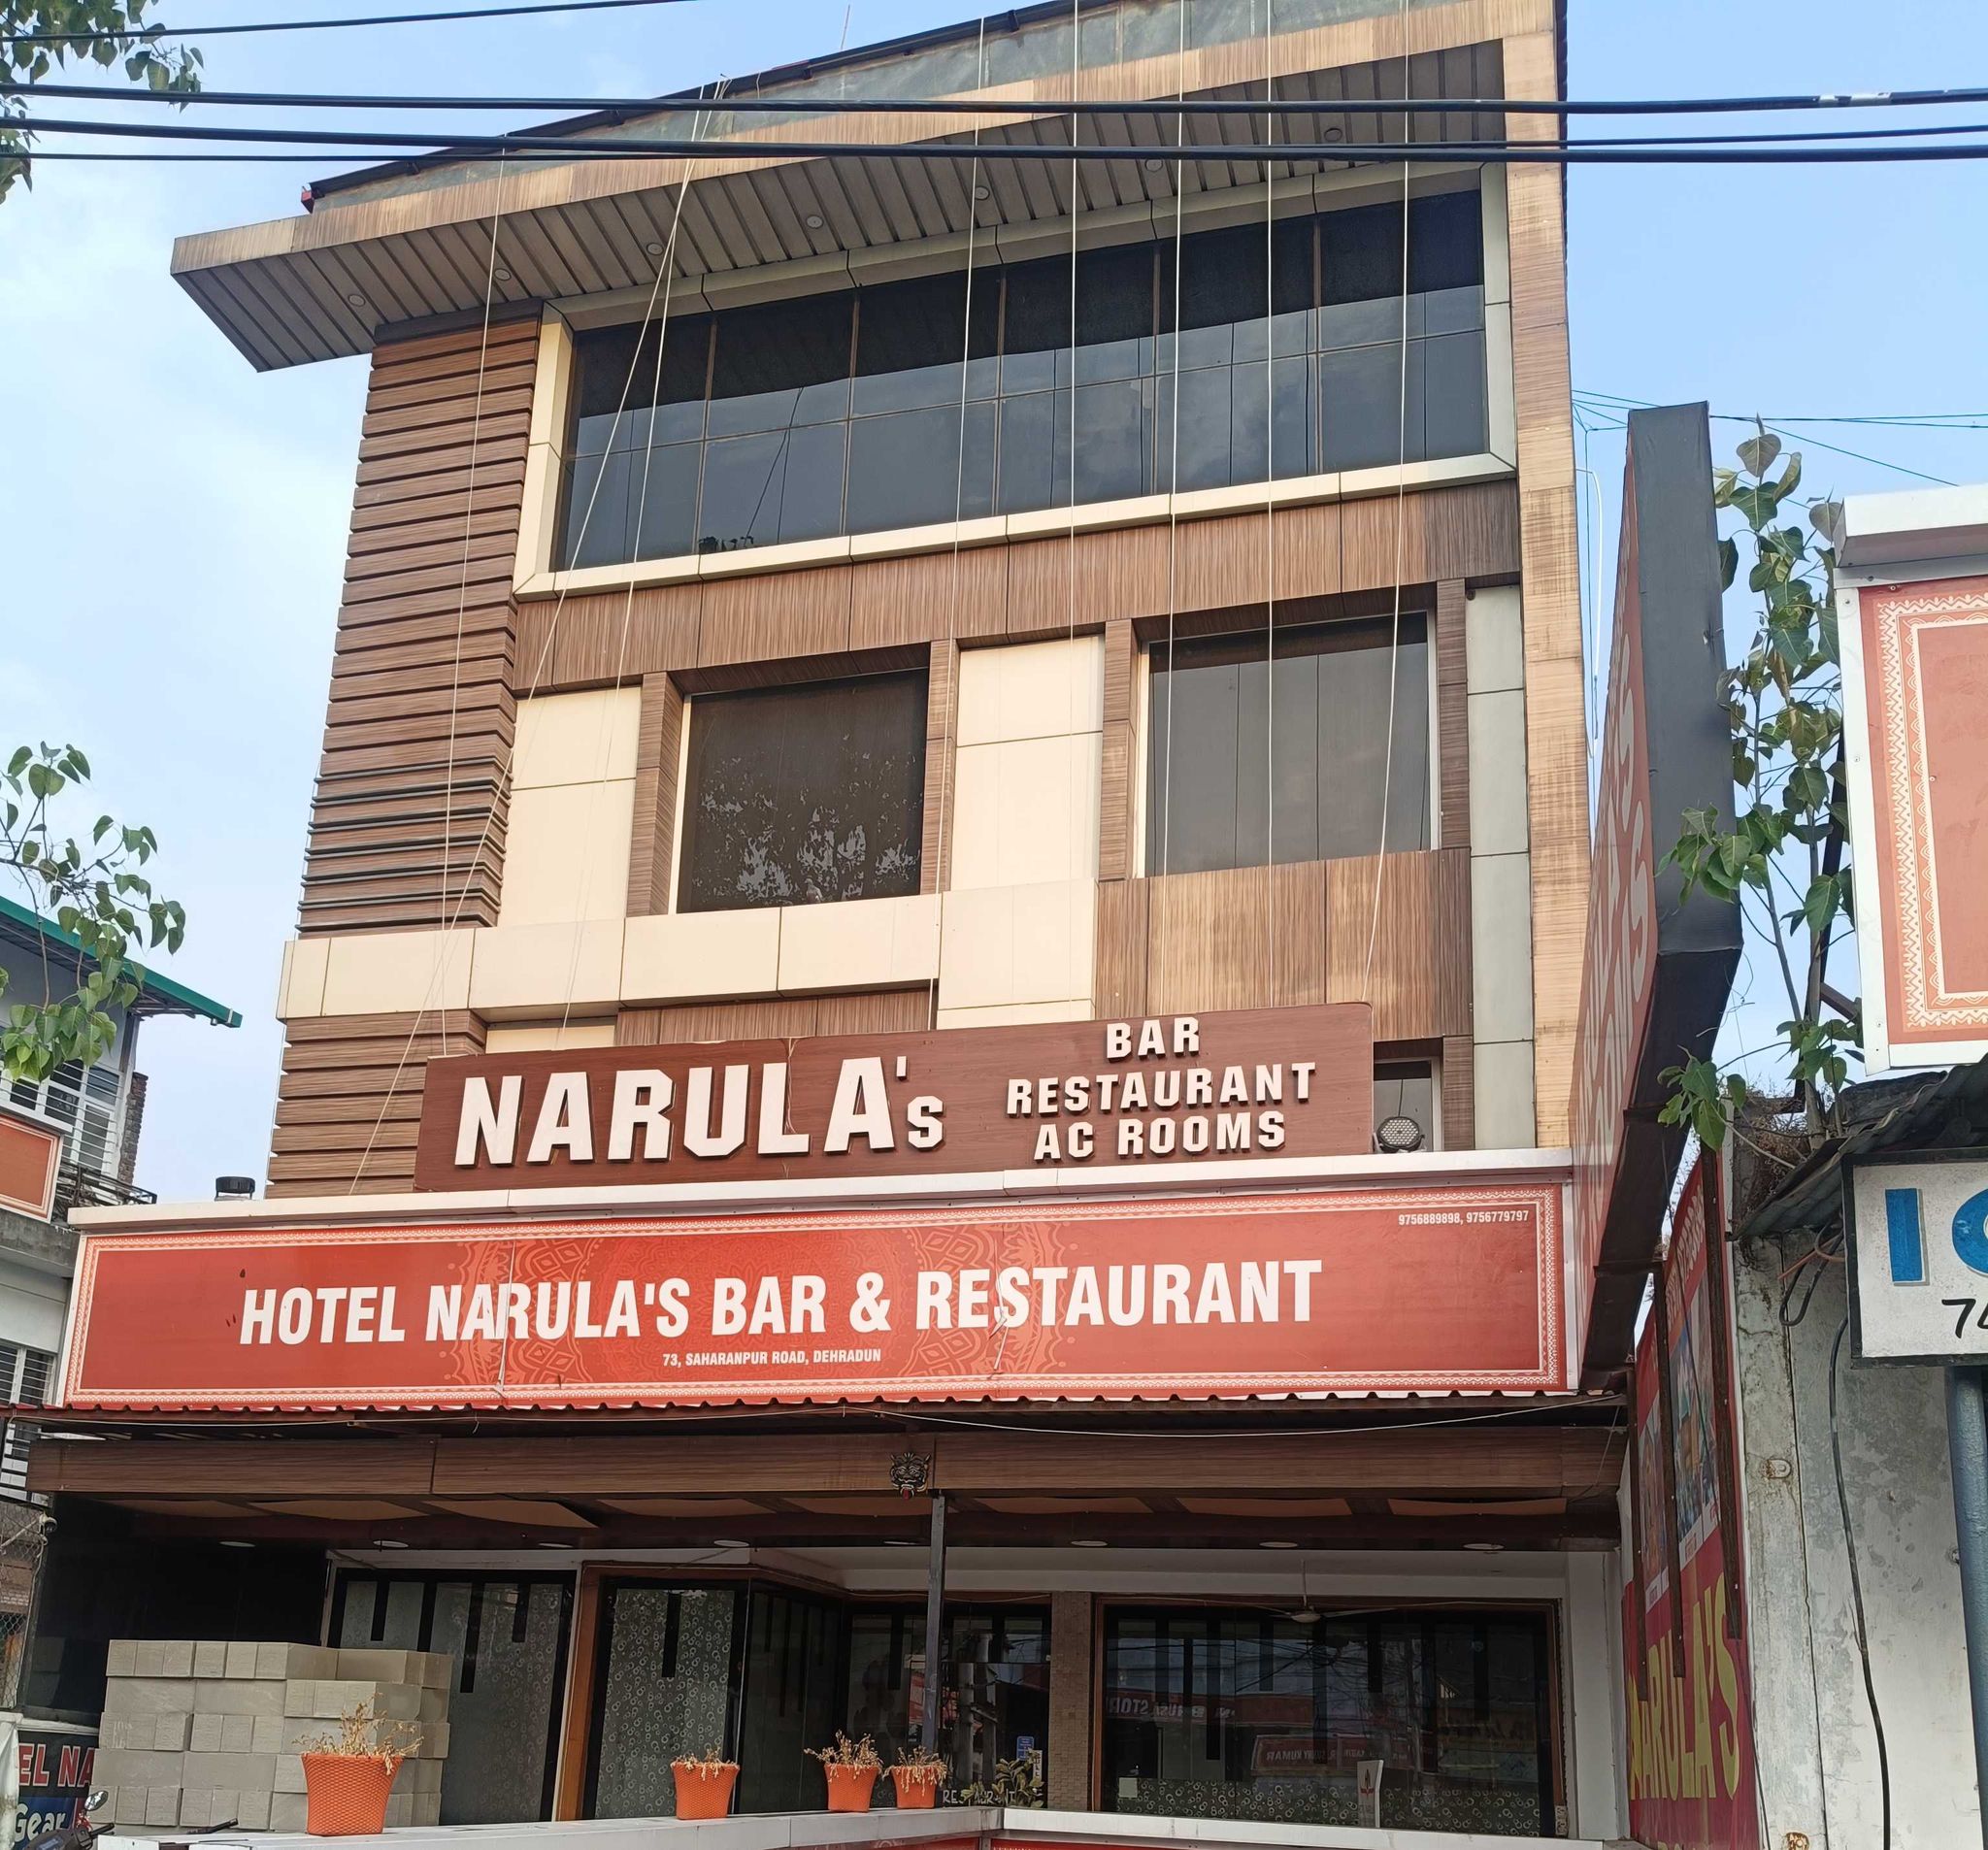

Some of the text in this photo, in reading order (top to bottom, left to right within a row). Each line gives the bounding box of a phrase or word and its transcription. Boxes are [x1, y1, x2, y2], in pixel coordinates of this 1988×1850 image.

[1107, 1017, 1200, 1060] BAR
[1589, 798, 1649, 1273] ROOMS
[1007, 1062, 1316, 1116] RESTAURANT
[1033, 1110, 1286, 1161] AC ROOMS
[1398, 1209, 1530, 1226] 9756889898, 9756779797
[240, 1259, 1323, 1345] HOTEL NARULA'S BAR & RESTAURANT
[1941, 1298, 1988, 1338] 7
[662, 1348, 881, 1369] 73, SAHARANPUR ROAD, DEHRADUN
